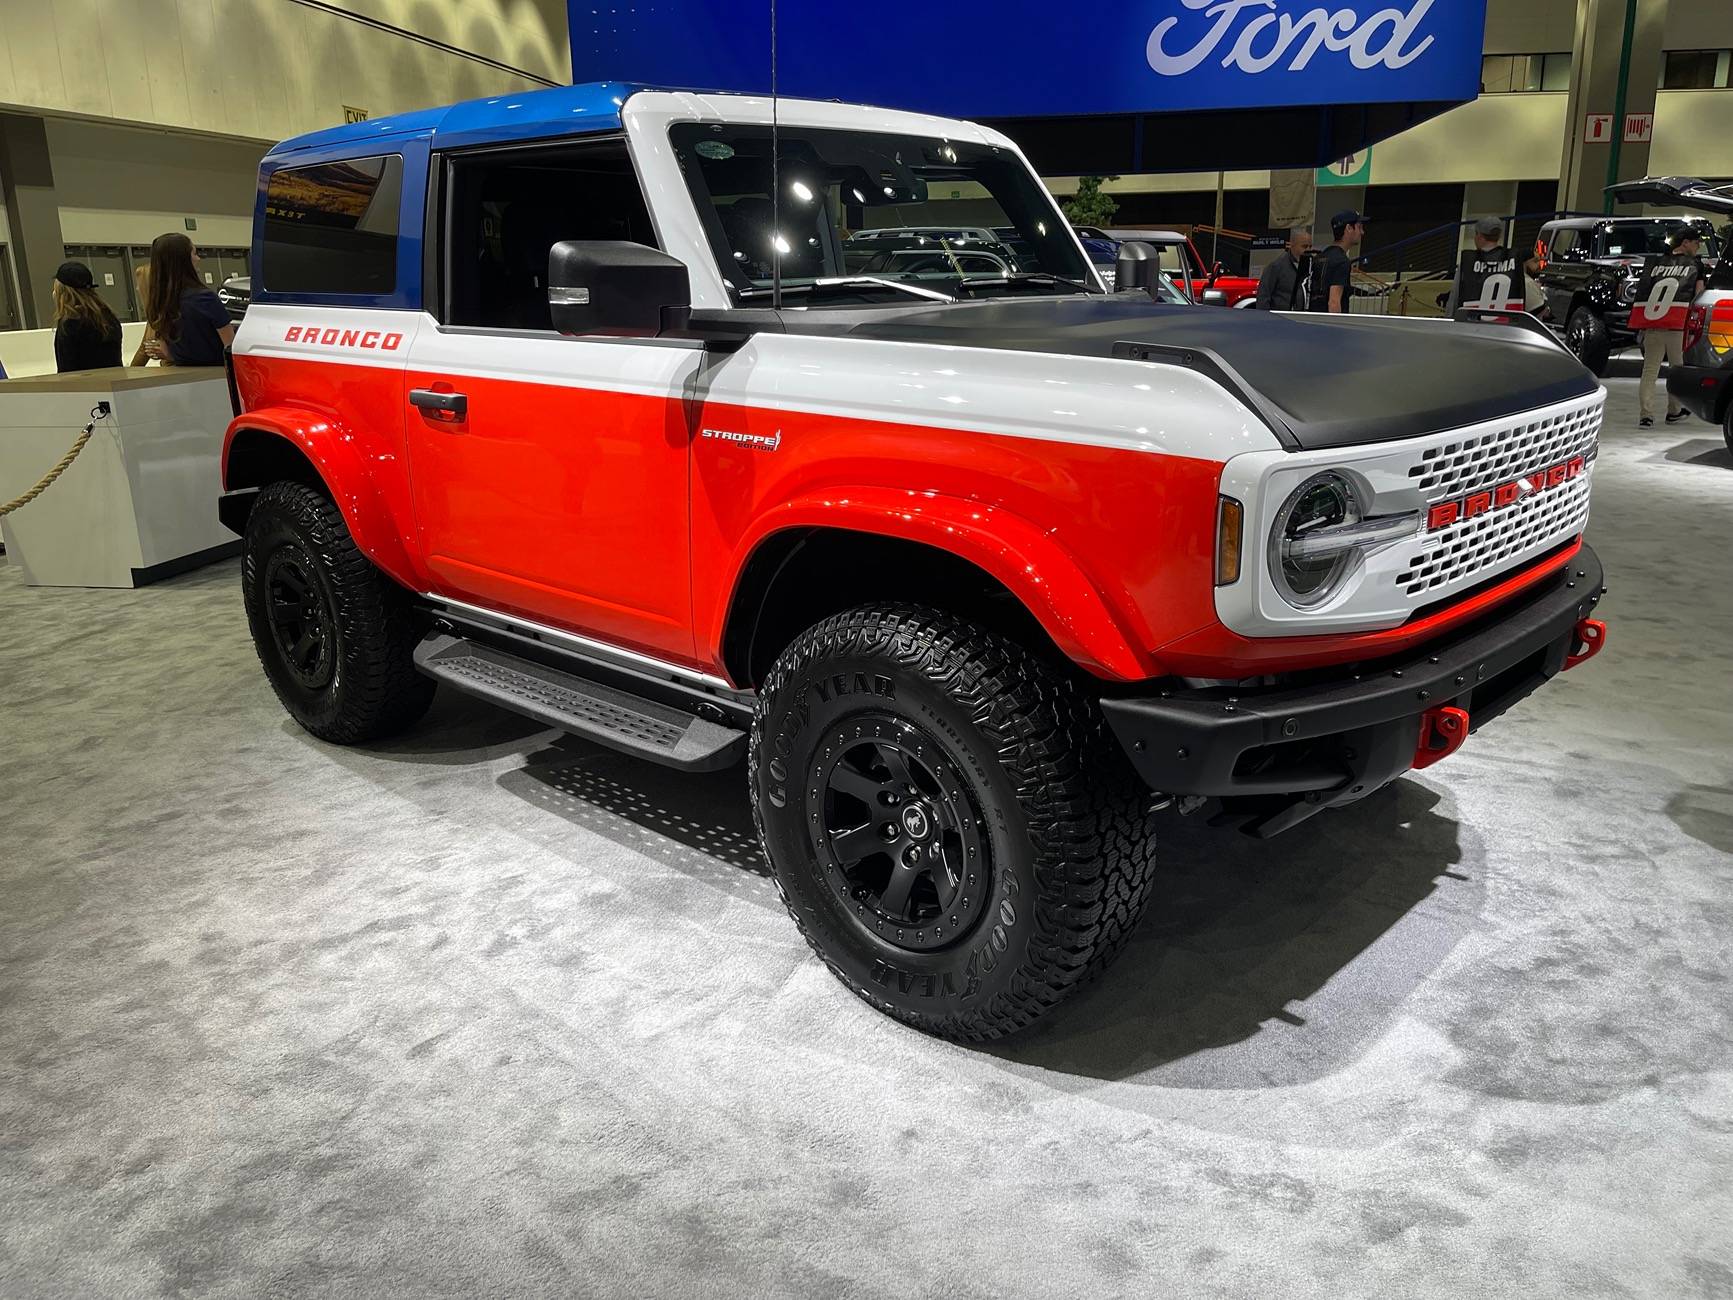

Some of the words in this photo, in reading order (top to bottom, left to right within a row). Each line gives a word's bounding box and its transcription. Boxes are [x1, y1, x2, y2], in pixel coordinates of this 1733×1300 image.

[1146, 0, 1435, 76] Ford
[1473, 258, 1516, 273] OPTIMA
[1650, 265, 1690, 277] OPTIMA
[1644, 277, 1680, 320] 0
[284, 326, 404, 351] BRONCO
[702, 429, 776, 446] STROPPE
